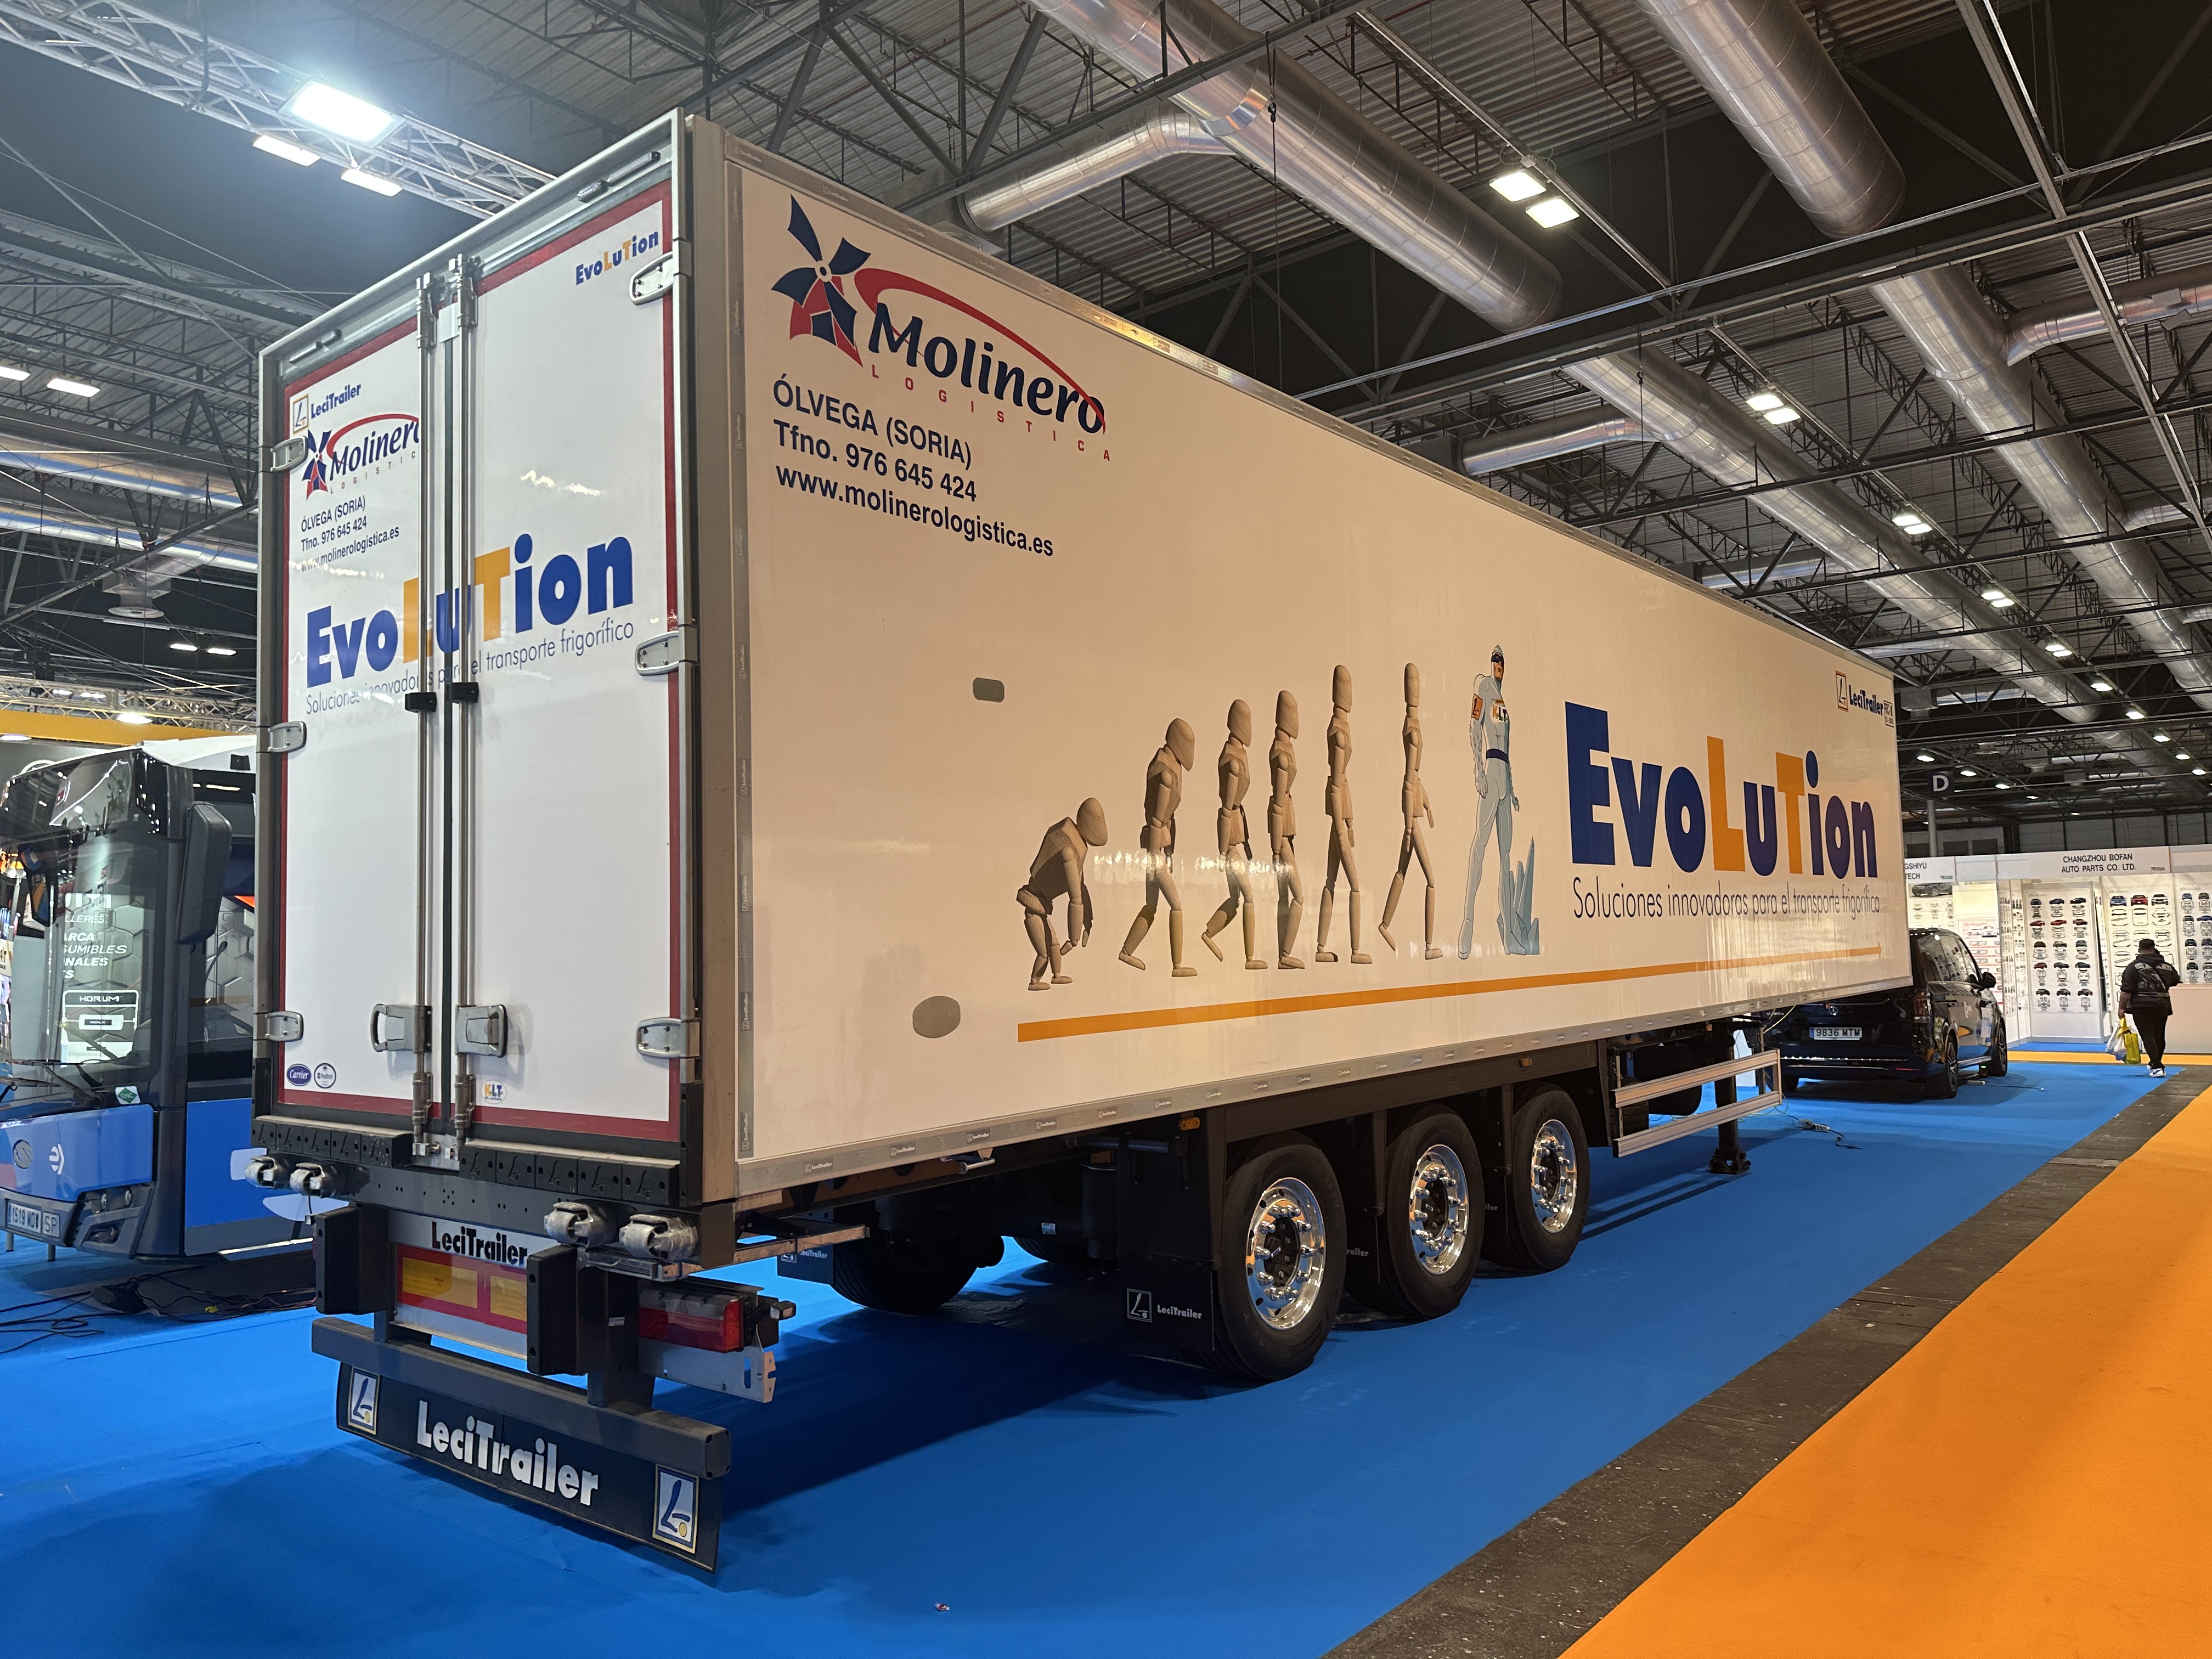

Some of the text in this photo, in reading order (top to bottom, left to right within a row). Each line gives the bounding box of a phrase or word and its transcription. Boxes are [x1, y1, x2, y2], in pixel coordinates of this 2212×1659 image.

[576, 232, 658, 285] EvoLuTion
[868, 302, 1105, 433] Molinero
[311, 384, 361, 419] LeciTrailer
[774, 373, 972, 470] ÓLVEGA (SORIA)
[872, 364, 1110, 461] LOGISTICA
[330, 452, 416, 494] LOGISTIC
[774, 420, 977, 502] Tfno. 976 645 424
[301, 495, 365, 532] ÓLVEGA (SORIA)
[301, 516, 366, 551] Tfno. 976 645 424
[776, 465, 1053, 557] www.molinerologistica.es
[302, 527, 399, 572] www.molinerologistica.es
[307, 533, 633, 688] EvoLuTion
[438, 663, 460, 689] par
[471, 650, 481, 675] el
[486, 638, 555, 670] transporte
[561, 618, 633, 656] frigorífico
[1849, 685, 1883, 715] LeciTrailer
[1565, 701, 1877, 879] EvoLuTion
[1933, 775, 1949, 792] D
[1573, 876, 1880, 923] Soluciones innovadoras para el transporte frigorífico
[64, 957, 108, 966] NALES
[1842, 1028, 1860, 1036] MTM
[290, 1069, 309, 1079] Carrier
[13, 1207, 25, 1226] 1519
[46, 1215, 57, 1233] SP
[431, 1221, 528, 1267] LeciTrailer
[800, 1249, 827, 1259] eciTrailer
[1157, 1304, 1202, 1319] LeciTrailer
[417, 1401, 599, 1506] LeciTrailer
